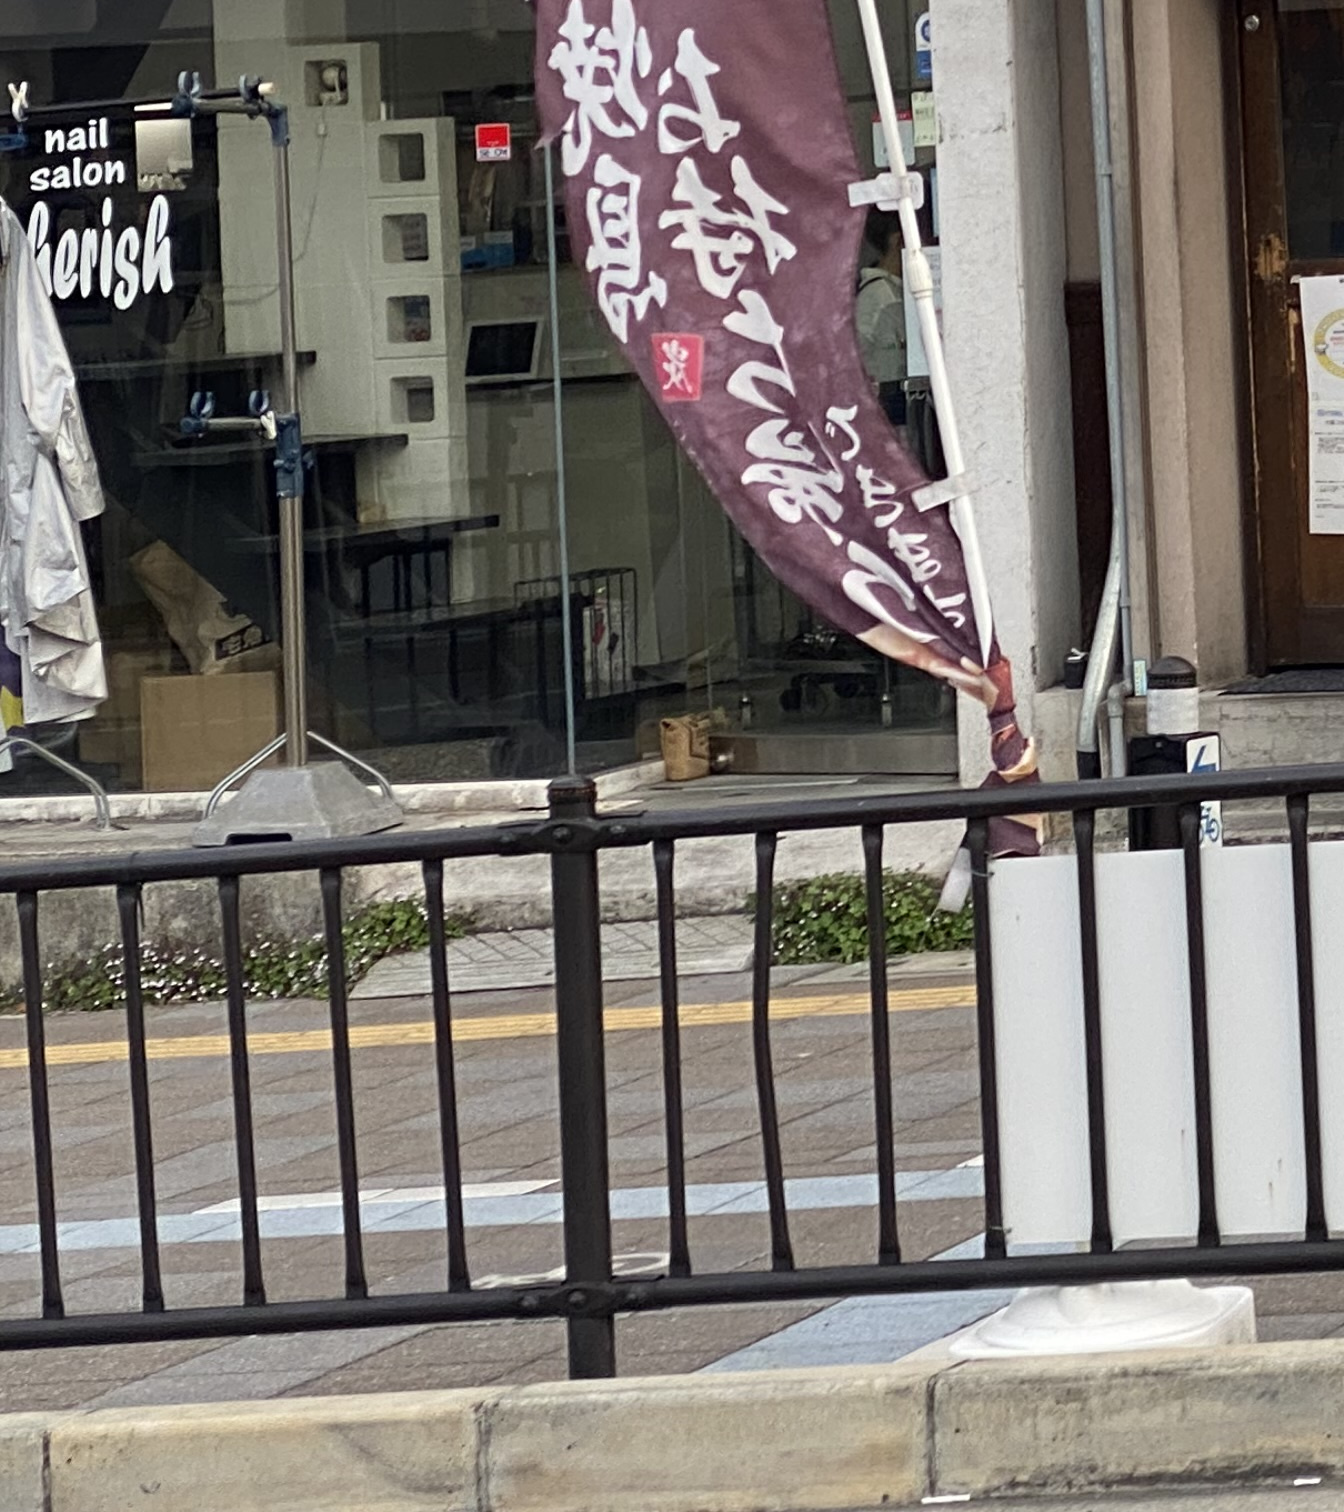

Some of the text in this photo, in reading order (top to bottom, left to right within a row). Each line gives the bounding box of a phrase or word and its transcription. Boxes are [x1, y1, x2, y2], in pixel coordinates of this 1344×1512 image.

[45, 117, 109, 154] nail
[30, 159, 126, 192] salon
[27, 194, 175, 311] herish
